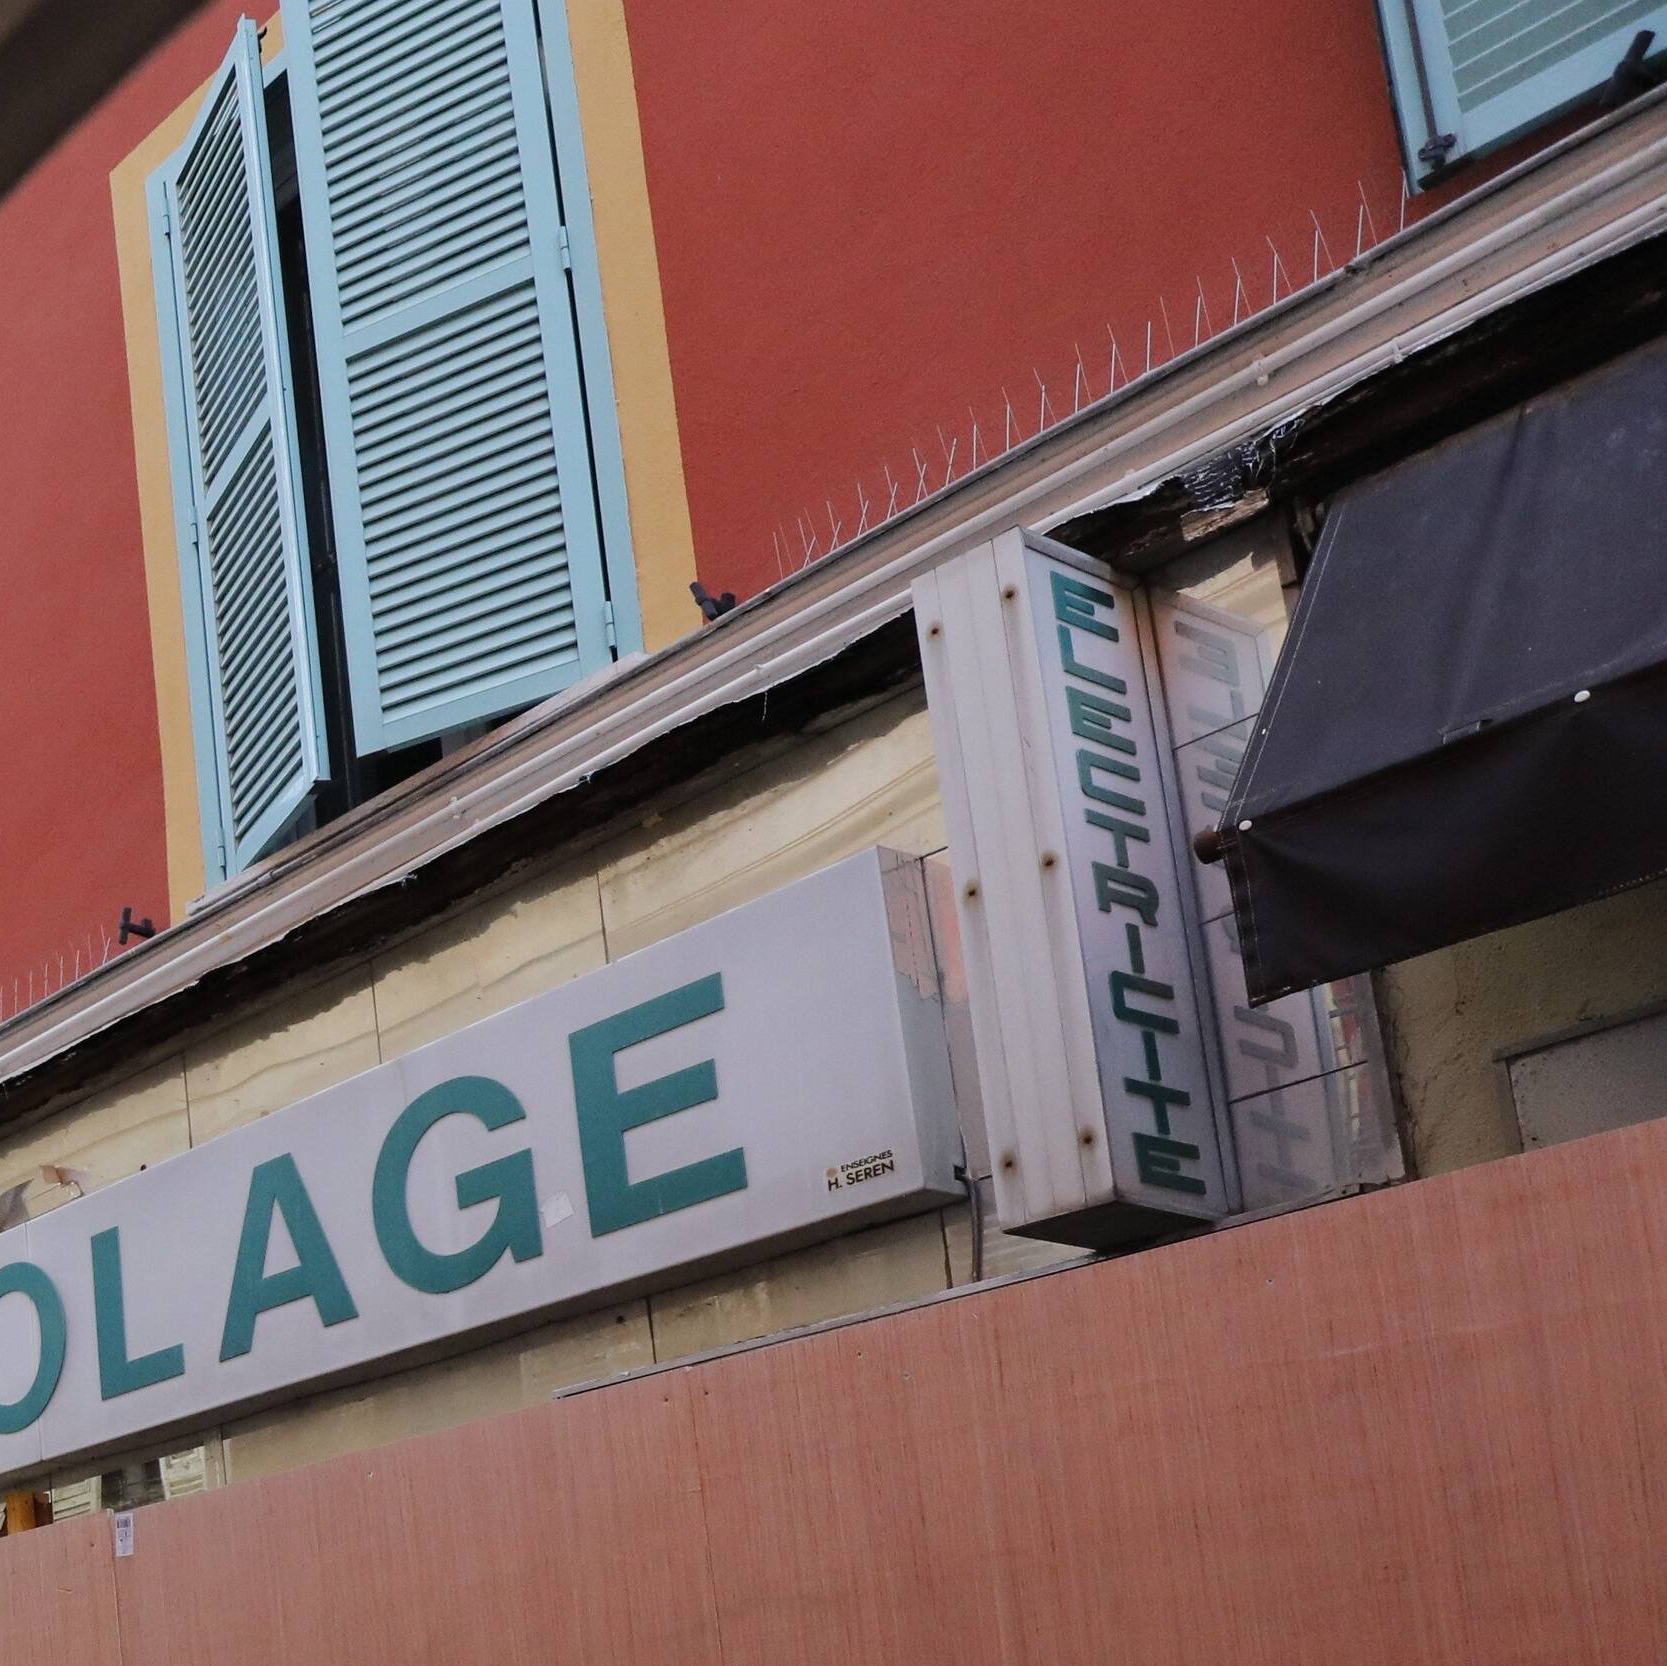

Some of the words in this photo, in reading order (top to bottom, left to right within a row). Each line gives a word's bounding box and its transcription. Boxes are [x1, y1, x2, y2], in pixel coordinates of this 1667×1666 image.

[1050, 569, 1207, 1196] ELECTRICITE
[827, 1177, 843, 1192] H.
[845, 1159, 895, 1186] SEREN
[840, 1149, 894, 1173] ENSEIGNES
